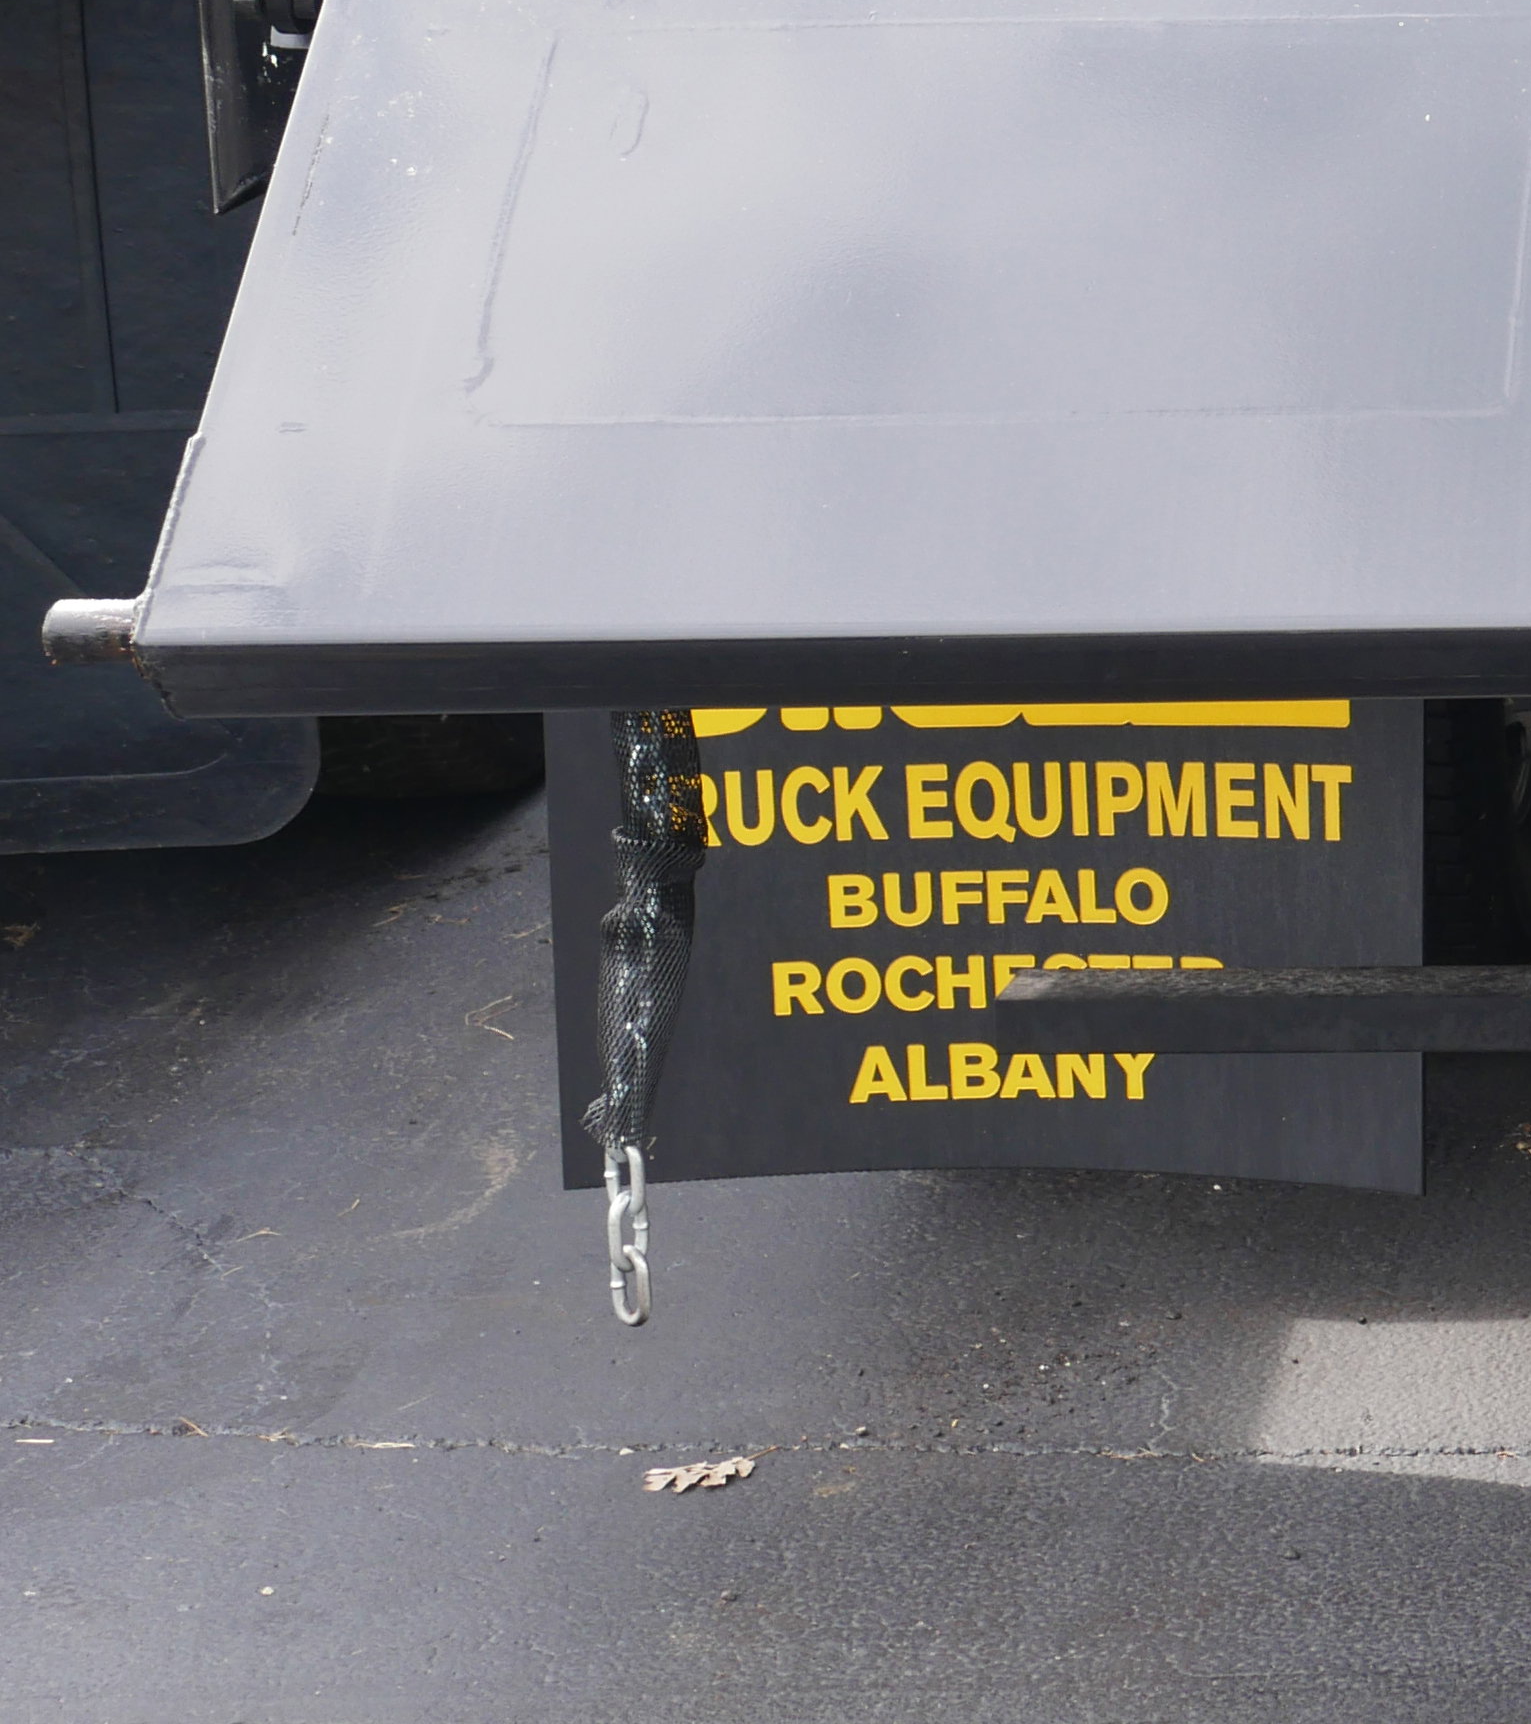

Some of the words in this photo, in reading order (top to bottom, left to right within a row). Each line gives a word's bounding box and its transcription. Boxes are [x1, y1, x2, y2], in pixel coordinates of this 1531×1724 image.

[696, 765, 889, 848] RUCK
[904, 760, 1353, 843] EQUIPMENT
[827, 867, 1169, 929] BUFFALO
[848, 1043, 1155, 1104] ALBANY
